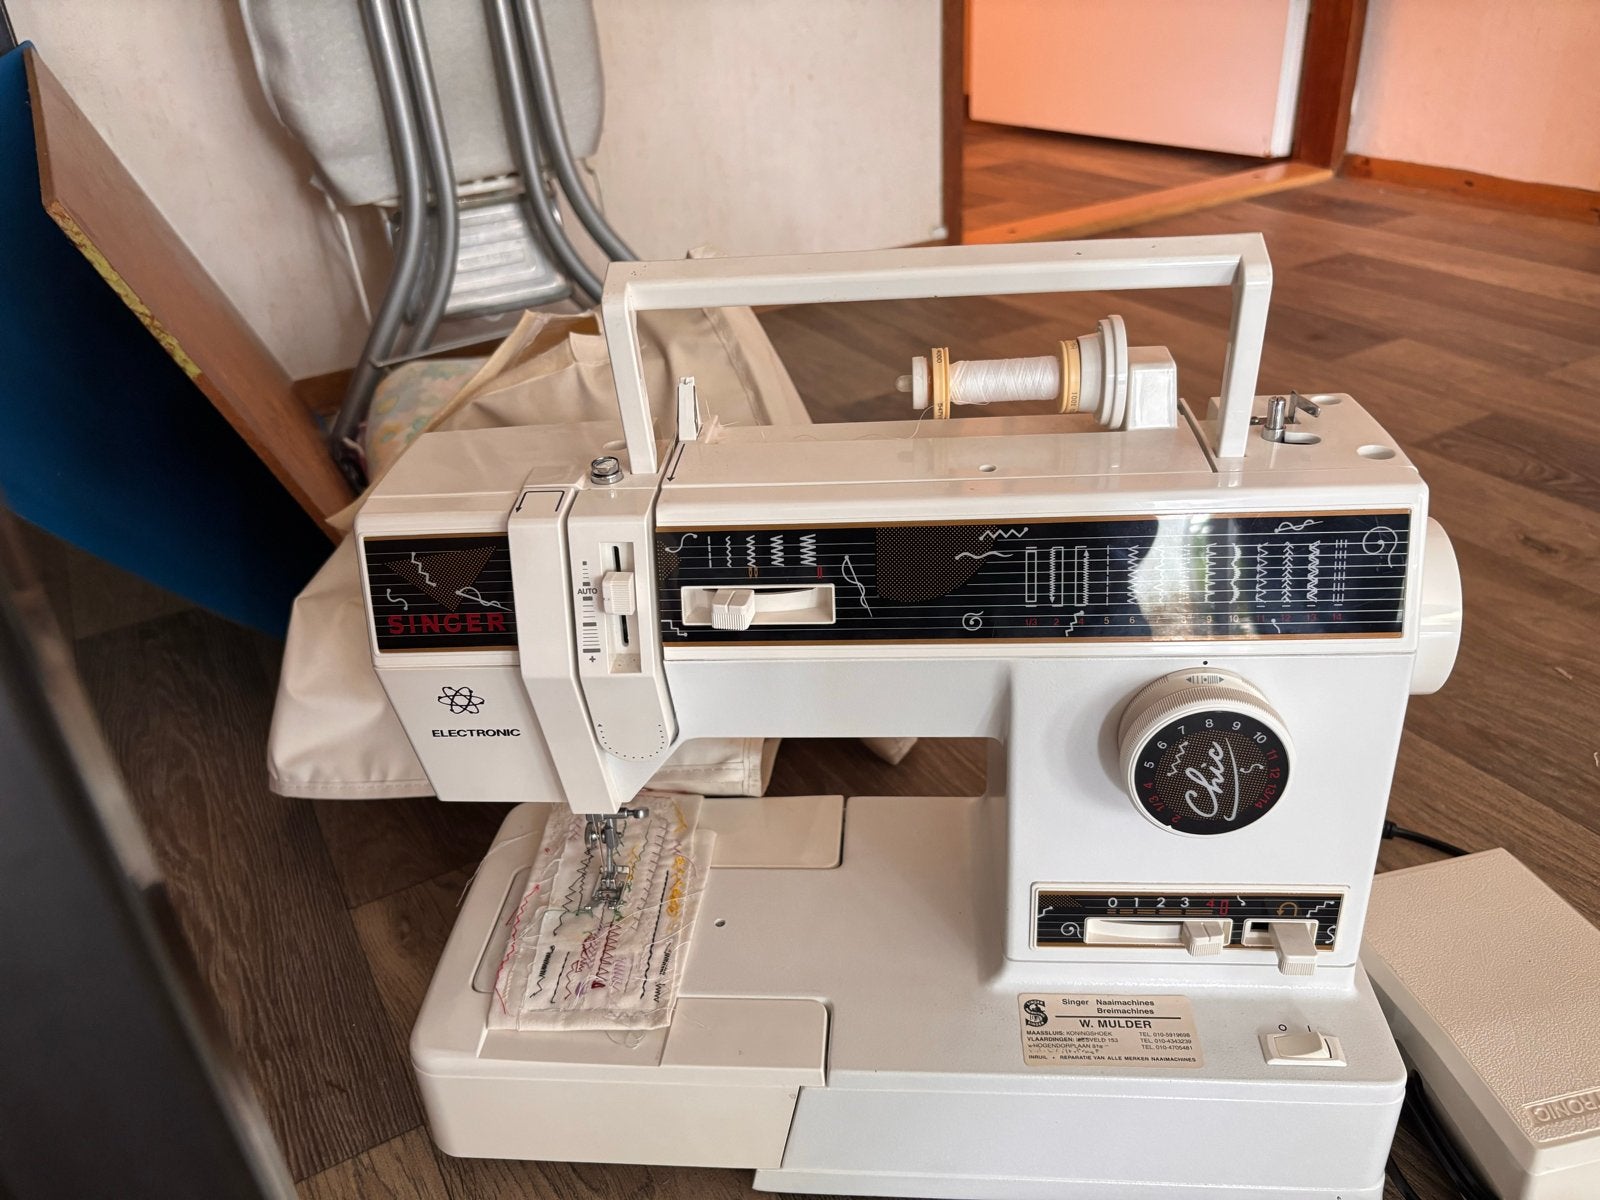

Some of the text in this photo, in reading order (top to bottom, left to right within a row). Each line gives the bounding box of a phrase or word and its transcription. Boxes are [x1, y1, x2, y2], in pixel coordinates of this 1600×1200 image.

[387, 613, 506, 635] SINGER
[1053, 617, 1060, 626] 2
[1103, 616, 1110, 624] 5
[1128, 615, 1135, 624] 6
[1206, 615, 1213, 623] 9
[1229, 614, 1240, 623] 10
[1256, 614, 1265, 622] 11
[1281, 614, 1292, 622] 12
[1306, 613, 1317, 621] 13
[1333, 612, 1343, 621] 14
[1205, 719, 1213, 729] 8
[1232, 720, 1241, 731] 9
[432, 729, 521, 738] ELECTRONIC
[1177, 725, 1186, 735] 7
[1253, 731, 1267, 744] 10
[1157, 740, 1168, 750] 6
[1266, 749, 1278, 761] 11
[1144, 761, 1155, 769] 5
[1268, 767, 1280, 778] 12
[1185, 741, 1224, 817] Chic
[1255, 784, 1277, 809] 13/14
[1148, 795, 1165, 812] 1/3
[1171, 814, 1183, 823] 2
[1107, 896, 1215, 907] 0 1 2 3 4
[1062, 998, 1155, 1007] Singer Naaimachines
[1096, 1007, 1155, 1015] Breimachines
[1079, 1019, 1152, 1029] W. MULDER
